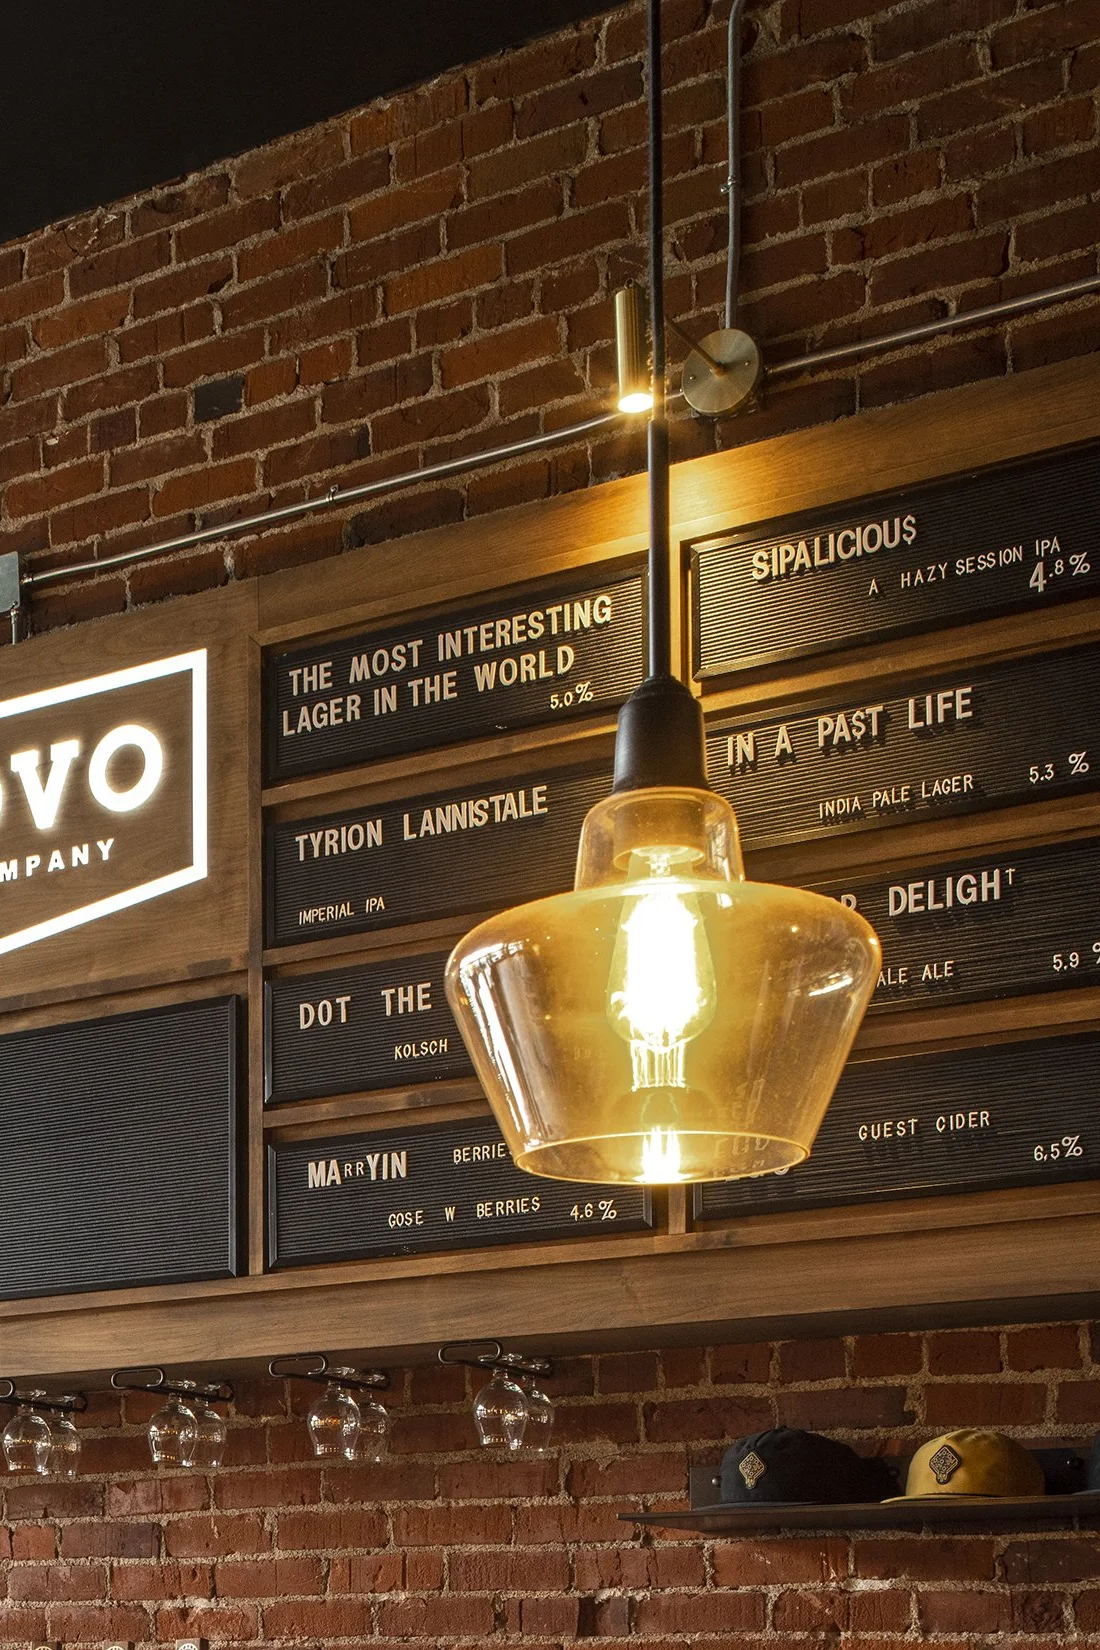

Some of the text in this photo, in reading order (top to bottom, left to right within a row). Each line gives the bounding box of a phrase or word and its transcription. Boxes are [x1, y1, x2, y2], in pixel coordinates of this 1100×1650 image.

[867, 535, 1061, 597] A HAZY SESSION IPA
[288, 593, 613, 698] THE MOST INTERESTING
[282, 644, 576, 738] LAGER IN THE WORLD
[726, 732, 755, 767] IN
[774, 725, 793, 759] A
[908, 686, 973, 731] LIFE
[818, 774, 974, 820] INDIA PALE LAGER
[295, 784, 549, 863] TYRION LANNISTALE
[298, 895, 386, 927] IMPERIAL IPA
[921, 960, 955, 983] ALE
[298, 981, 433, 1031] DOT THE
[393, 1037, 450, 1062] KOLSCH
[857, 1110, 991, 1142] GUEST CIDER
[453, 1142, 514, 1165] BERRIE
[388, 1196, 542, 1229] GOSE W BERRIES
